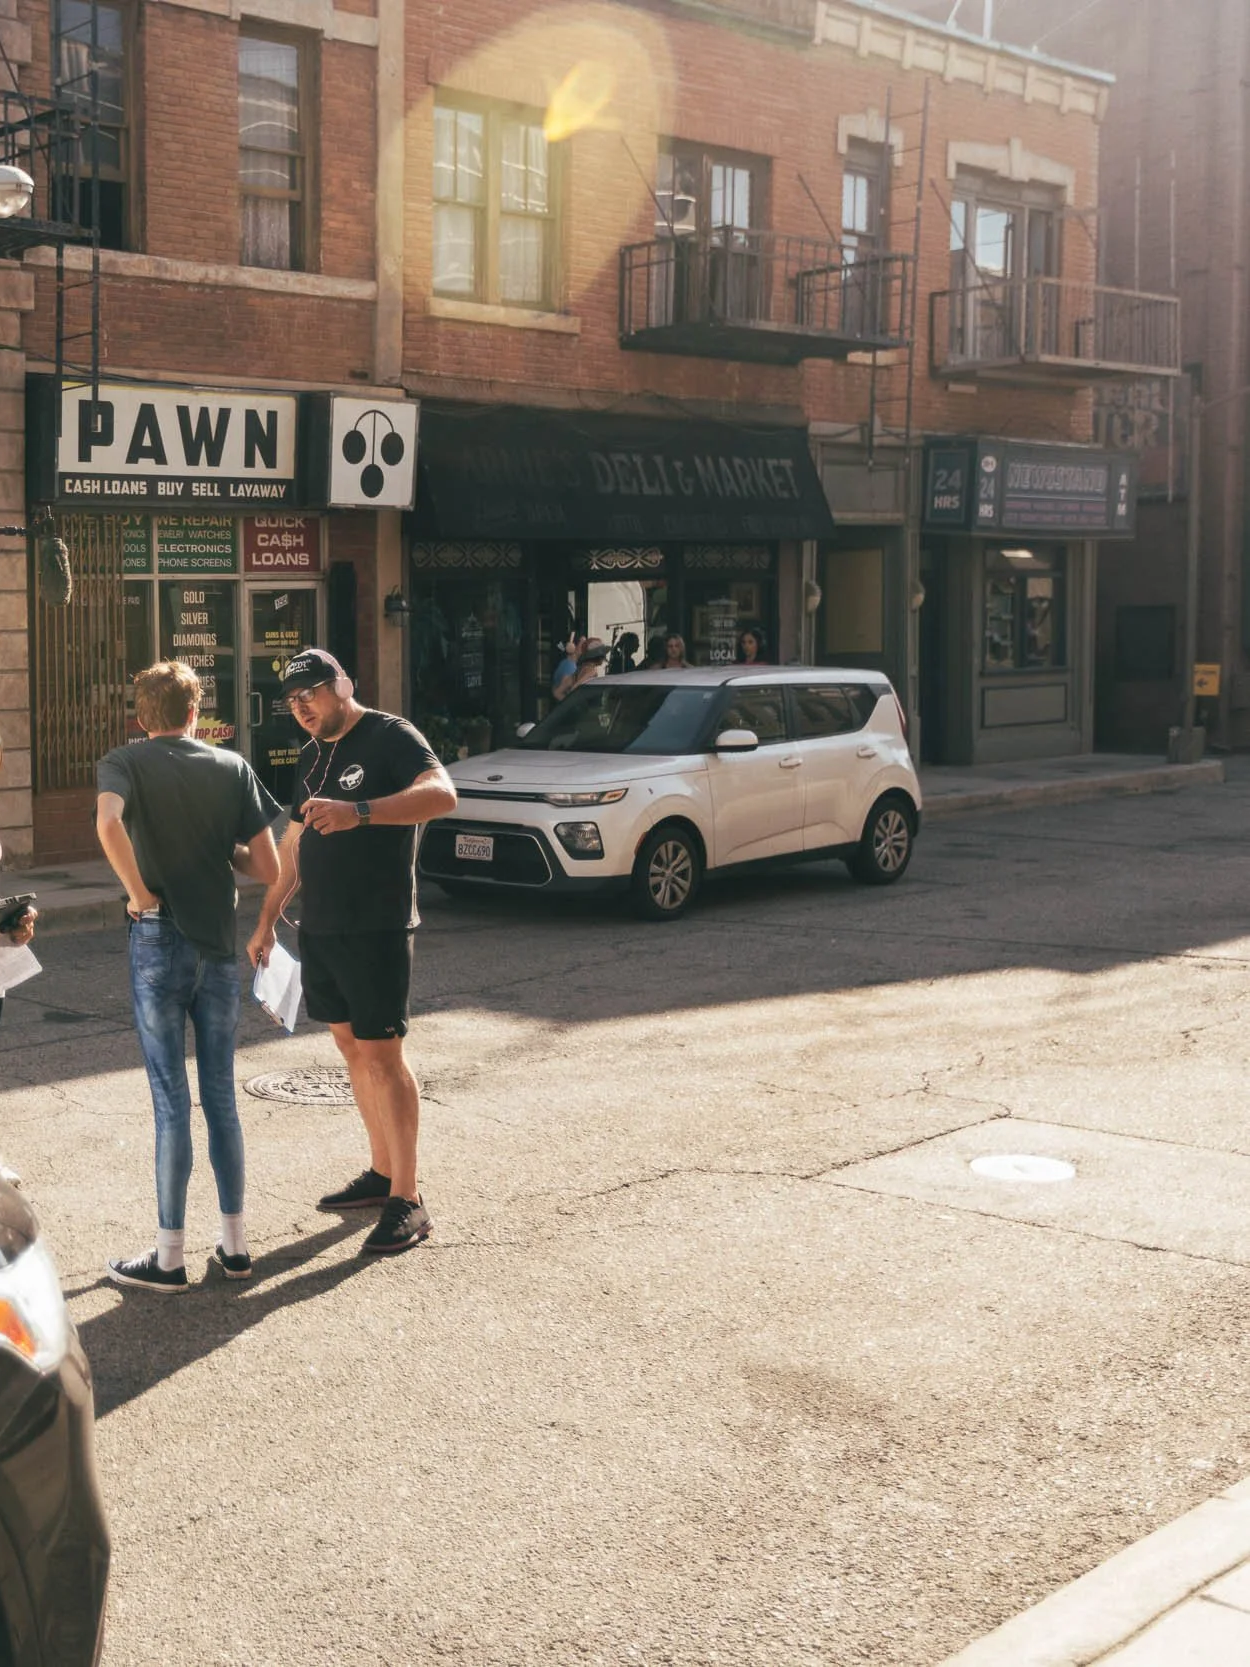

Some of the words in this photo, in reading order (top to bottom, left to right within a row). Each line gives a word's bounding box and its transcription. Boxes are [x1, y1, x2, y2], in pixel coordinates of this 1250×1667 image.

[77, 398, 279, 470] PAWN
[592, 450, 673, 496] DELI
[674, 460, 694, 496] &
[694, 453, 802, 499] MARKET
[934, 469, 962, 491] 24
[64, 478, 101, 494] CASH
[103, 480, 148, 496] LOANS
[157, 482, 185, 497] BUY
[191, 483, 222, 497] SELL
[229, 484, 287, 499] LAYAWAY
[980, 476, 995, 499] 24
[1117, 473, 1128, 516] ATM
[933, 495, 960, 509] HRS
[978, 503, 994, 518] HRS
[158, 515, 179, 526] WE
[182, 515, 232, 527] REPAIR
[254, 515, 306, 529] QUICK
[158, 530, 184, 539] EWELRY
[188, 530, 232, 540] WATCHES
[257, 531, 304, 550] CA$H
[124, 543, 147, 553] OOLS
[158, 543, 232, 553] ELECTRONICS
[158, 557, 189, 567] PHONE
[191, 557, 232, 567] SCREENS
[251, 552, 310, 566] LOANS
[183, 591, 205, 604] GOLD
[180, 612, 209, 625] SILVER
[173, 633, 217, 647] DIAMONDS
[265, 631, 280, 639] GUNS
[175, 654, 215, 668] WATCHES
[709, 649, 737, 661] LOCAL
[195, 728, 210, 739] TOP
[211, 725, 236, 739] CASH
[457, 843, 491, 857] 8ZCC690
